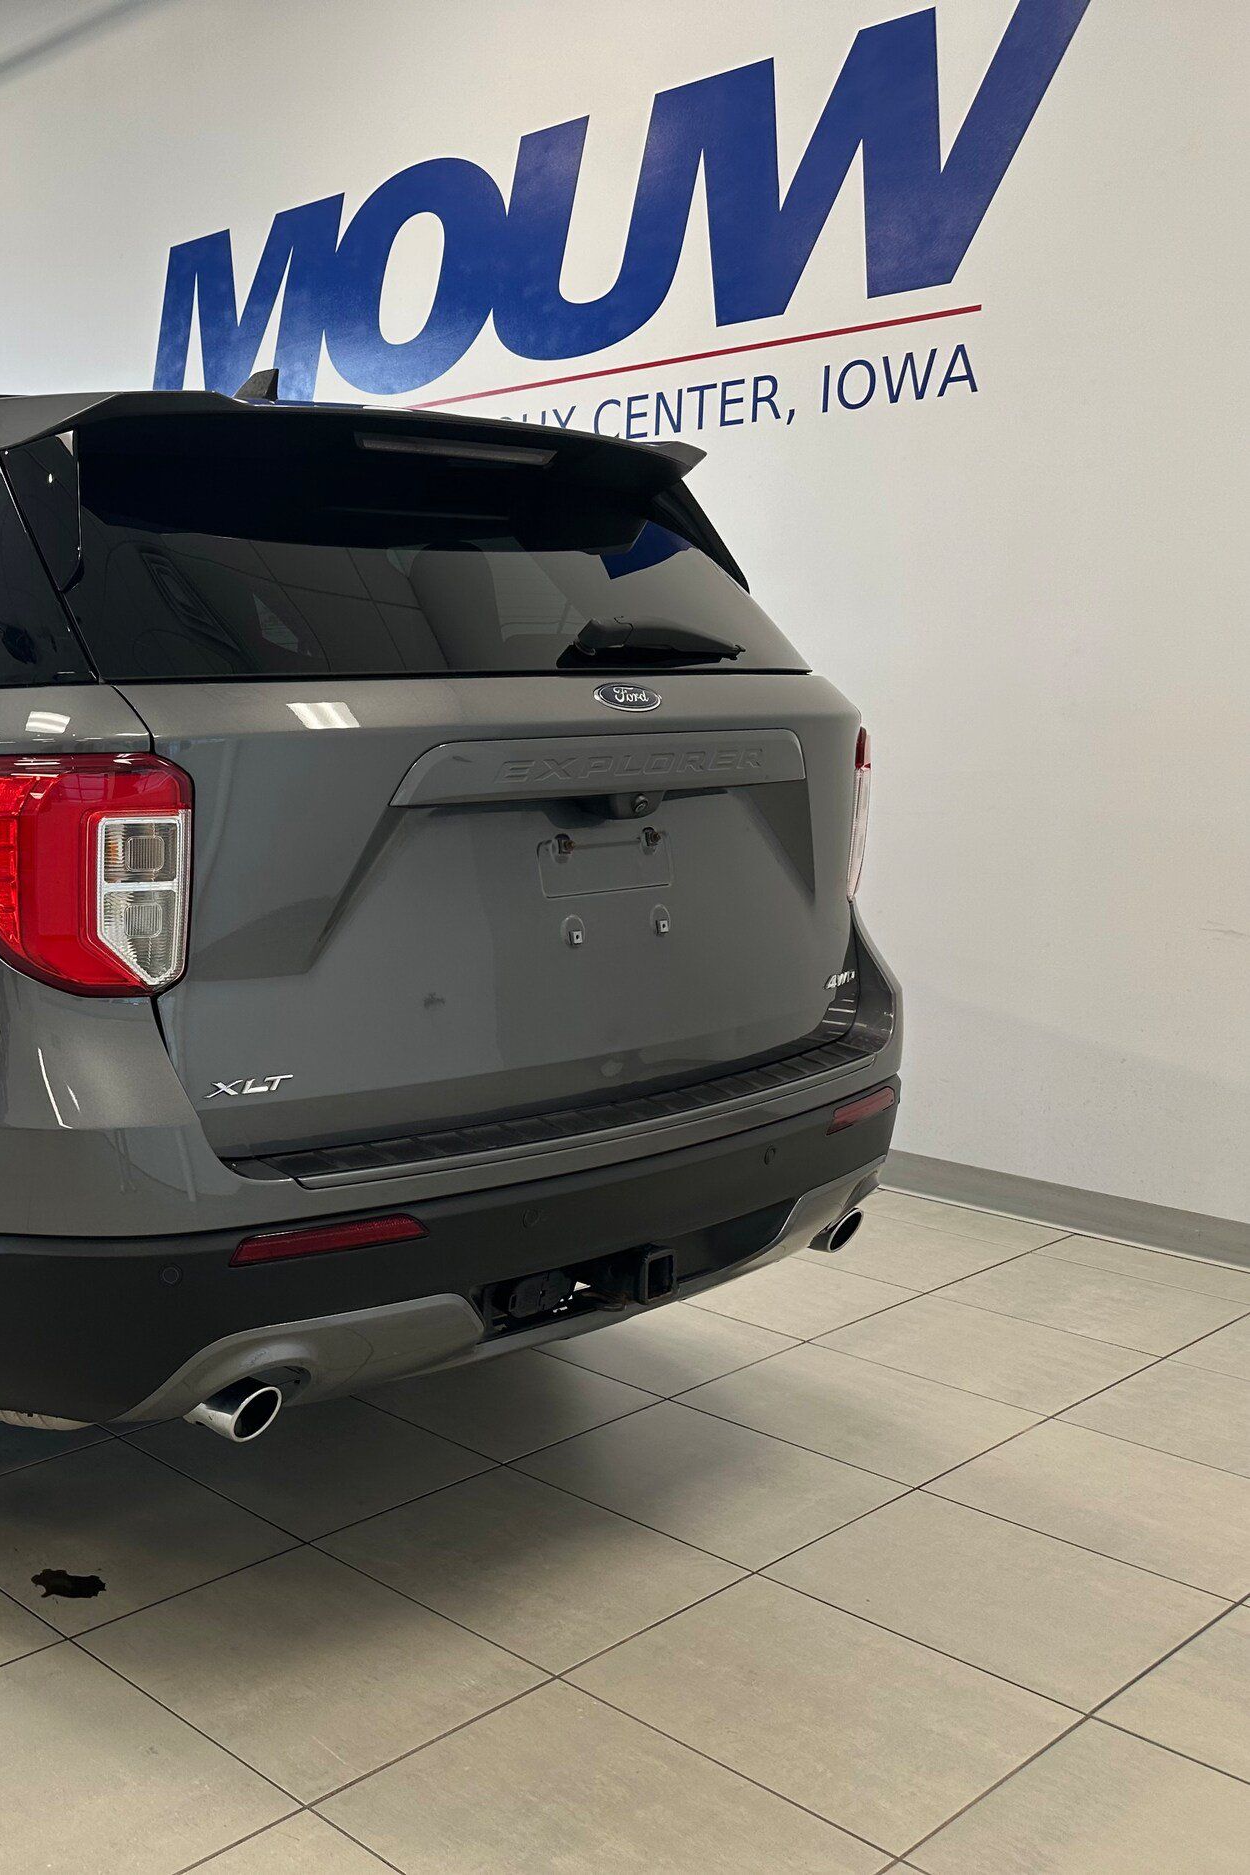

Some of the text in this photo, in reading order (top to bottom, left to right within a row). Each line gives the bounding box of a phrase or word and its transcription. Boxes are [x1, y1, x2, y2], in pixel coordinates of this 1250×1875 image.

[152, 0, 1091, 403] MOUW
[593, 343, 979, 440] CENTER, IOWA
[496, 748, 763, 784] EXPLORER
[203, 1073, 294, 1099] XLT
